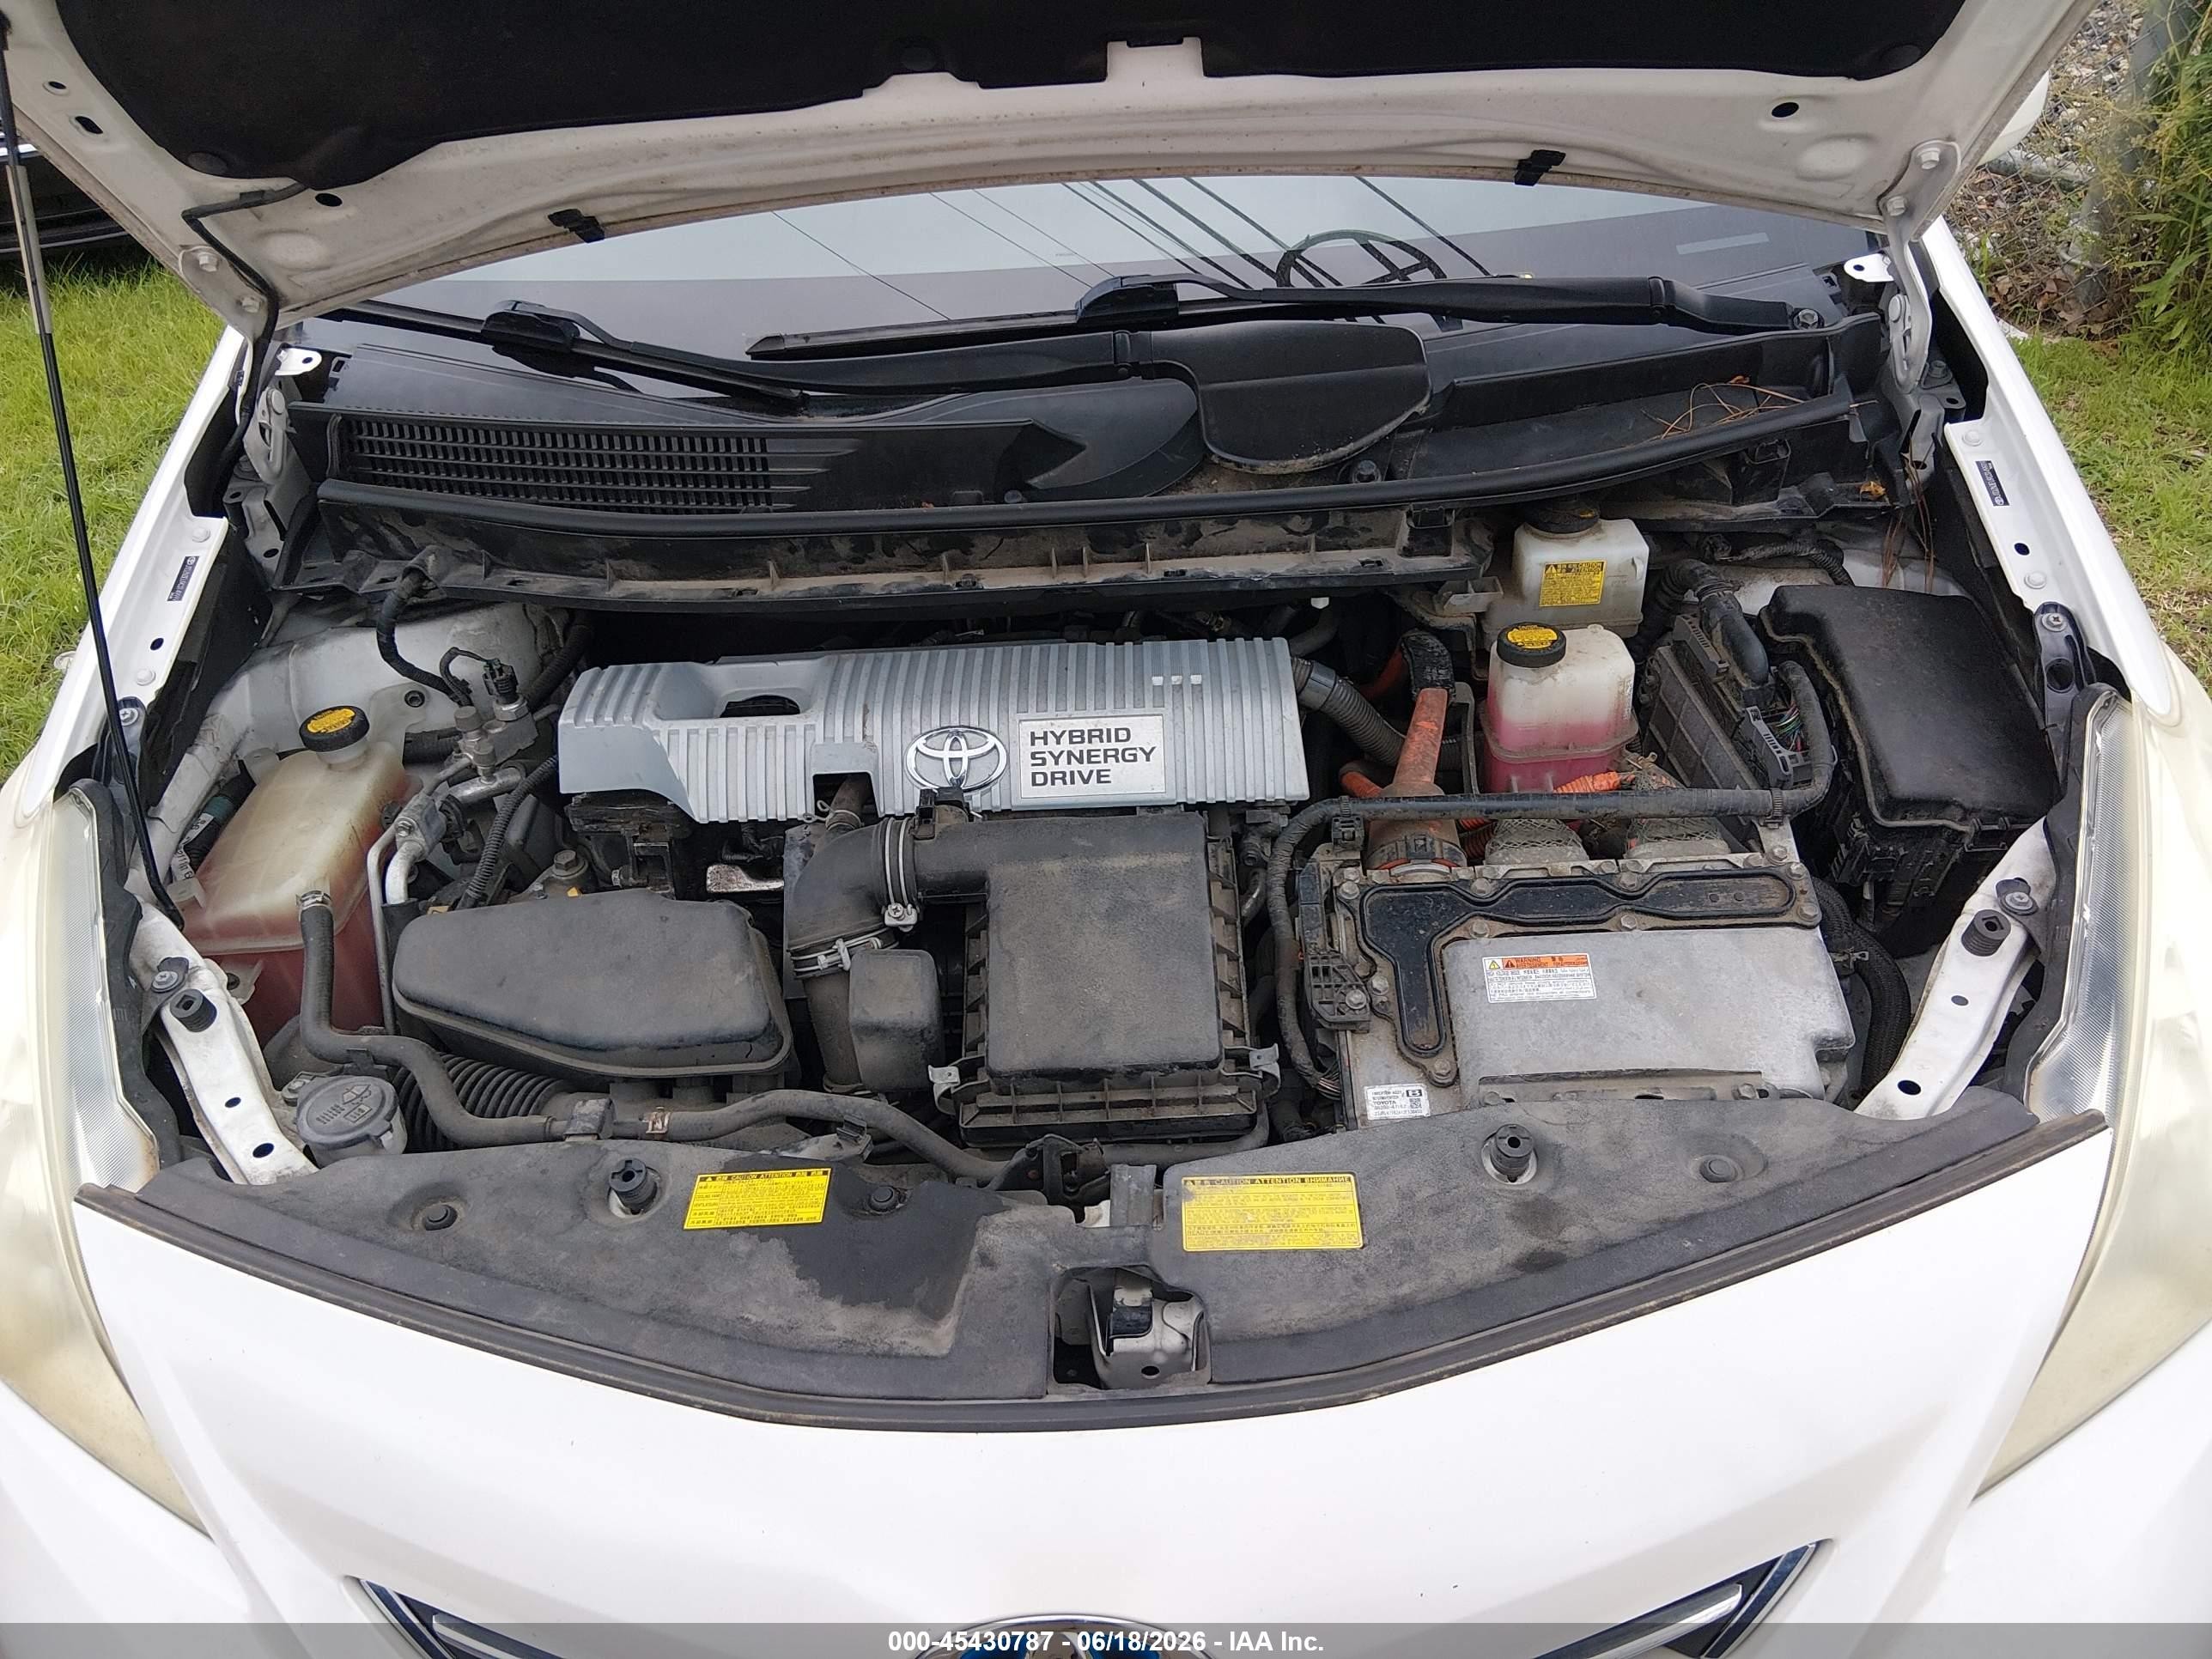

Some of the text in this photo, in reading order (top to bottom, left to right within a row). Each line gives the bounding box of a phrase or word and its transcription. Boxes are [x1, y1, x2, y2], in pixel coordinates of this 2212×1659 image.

[1030, 727, 1132, 746] HYBRID
[1030, 746, 1156, 767] SYNERGY
[1031, 769, 1112, 787] DRIVE
